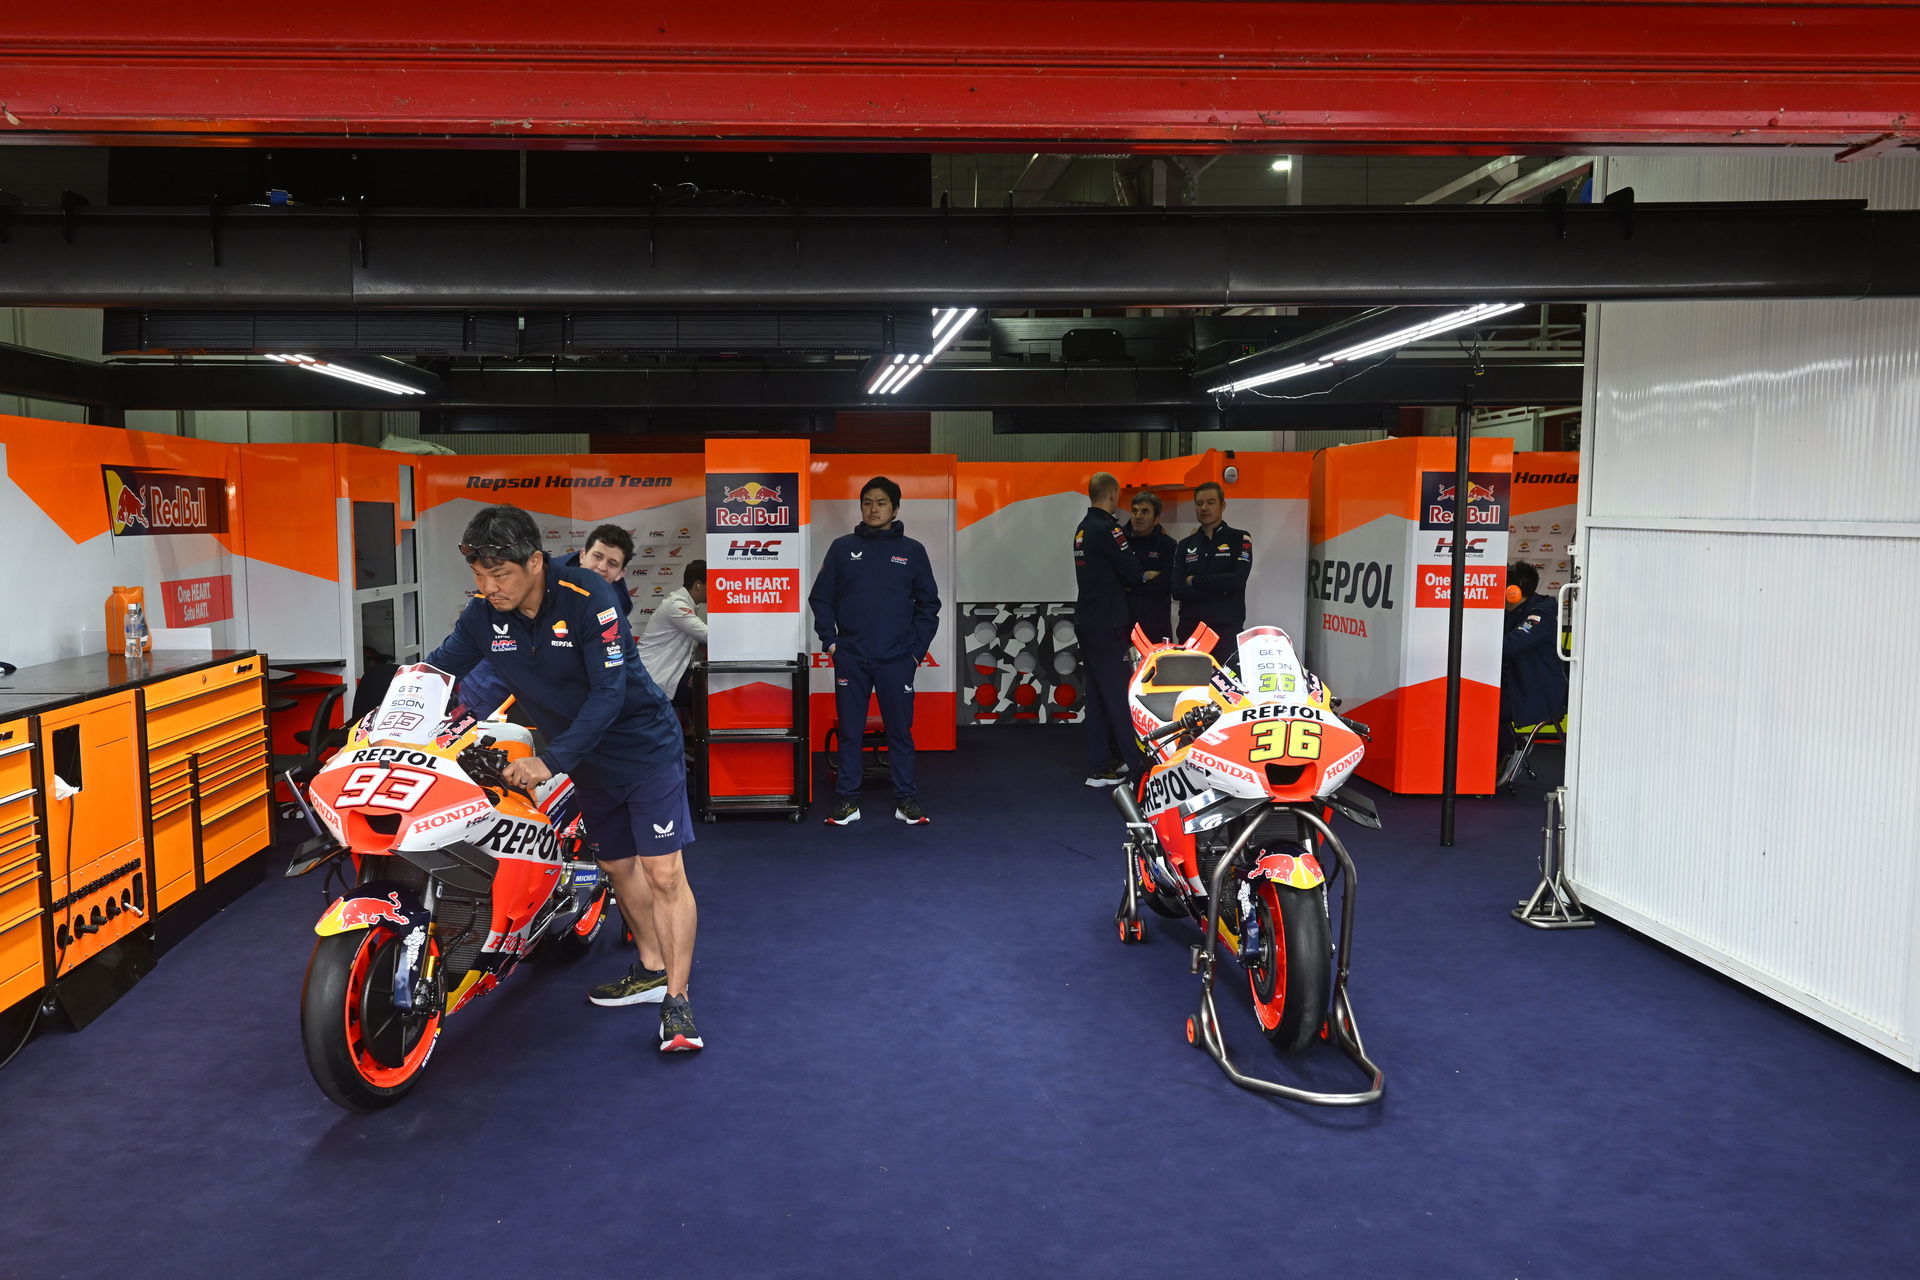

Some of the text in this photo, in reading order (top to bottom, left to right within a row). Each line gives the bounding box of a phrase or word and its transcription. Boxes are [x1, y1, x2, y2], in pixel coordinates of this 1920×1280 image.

[466, 475, 673, 491] Repsol Honda Team
[1513, 471, 1579, 484] Honda
[151, 485, 207, 528] Red Bull
[1429, 505, 1500, 524] Re Bull
[716, 506, 789, 526] Red Bull
[728, 540, 782, 556] HRC
[1435, 537, 1488, 553] HC
[715, 577, 791, 591] One HEART.
[1307, 558, 1394, 609] REPSOL
[1425, 572, 1498, 587] One EART.
[178, 585, 191, 603] One
[726, 592, 783, 605] Satu HATI.
[1434, 587, 1451, 600] Sat
[1322, 613, 1368, 638] HONDA
[551, 640, 574, 648] REPSOL
[398, 685, 423, 694] GET
[1258, 672, 1296, 693] 36
[391, 699, 425, 710] SOON
[1242, 704, 1325, 722] REPSOL
[377, 711, 425, 731] 93
[1248, 719, 1323, 763] 36
[351, 748, 438, 770] REPSOL
[1191, 750, 1257, 784] HONDA
[1325, 746, 1364, 781] HONDA
[334, 766, 438, 813] 93
[412, 800, 492, 834] HONDA
[465, 811, 491, 827] HRC
